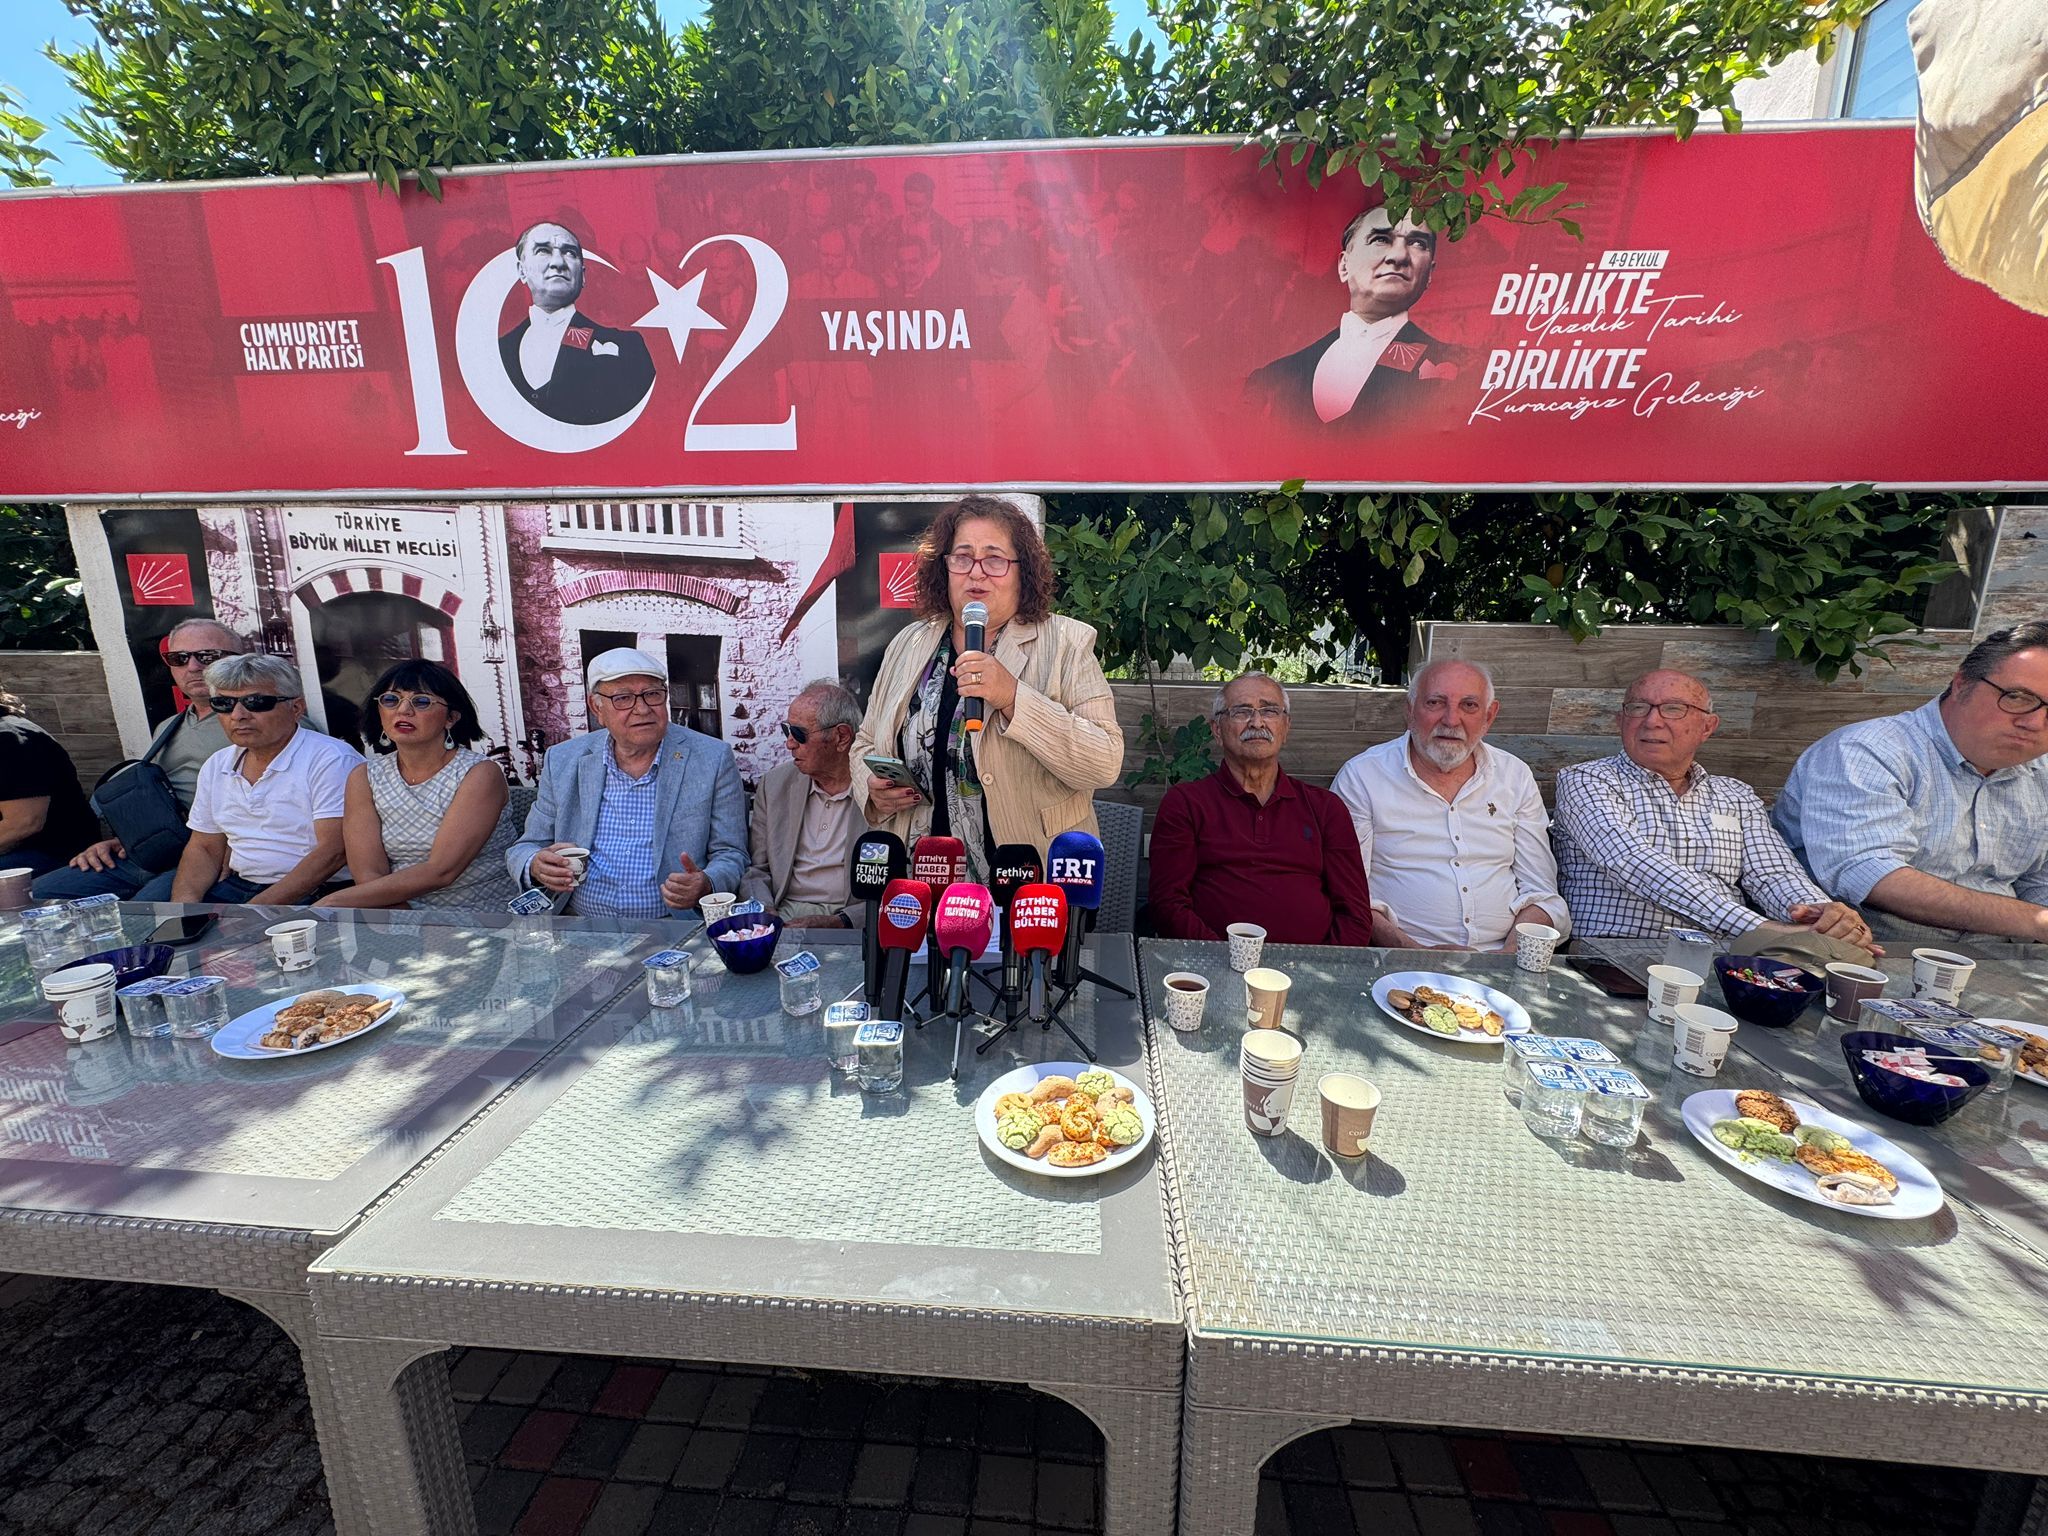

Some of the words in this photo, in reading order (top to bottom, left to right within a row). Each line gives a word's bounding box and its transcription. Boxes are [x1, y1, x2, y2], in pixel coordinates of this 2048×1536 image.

[1609, 252, 1628, 267] 4-9
[1628, 252, 1660, 267] EYLÜL
[1490, 263, 1661, 316] BİRLİKTE
[1645, 294, 1743, 341] Tarihi
[240, 319, 359, 347] CUMHURİYET
[821, 309, 971, 357] YAŞINDA
[244, 346, 293, 371] HALK
[295, 344, 365, 370] PARTİSİ
[1480, 340, 1648, 390] BİRLİKTE
[1468, 384, 1626, 425] Kuracağız
[1633, 372, 1765, 418] Geleceği
[335, 512, 402, 532] TÜRKİYE
[289, 532, 338, 551] BÜYÜK
[344, 535, 391, 554] MİLLET
[396, 539, 457, 557] MECLİSİ
[918, 855, 948, 863] FETHİYE
[1052, 858, 1096, 879] FRT
[856, 863, 889, 876] FETHİYE
[856, 874, 886, 885] FORUM
[996, 867, 1034, 879] Fethiye
[946, 896, 980, 908] FETHİYE
[1015, 896, 1059, 908] FETHİYE
[1016, 907, 1056, 917] HABER
[1014, 917, 1059, 929] BÜLTENİ
